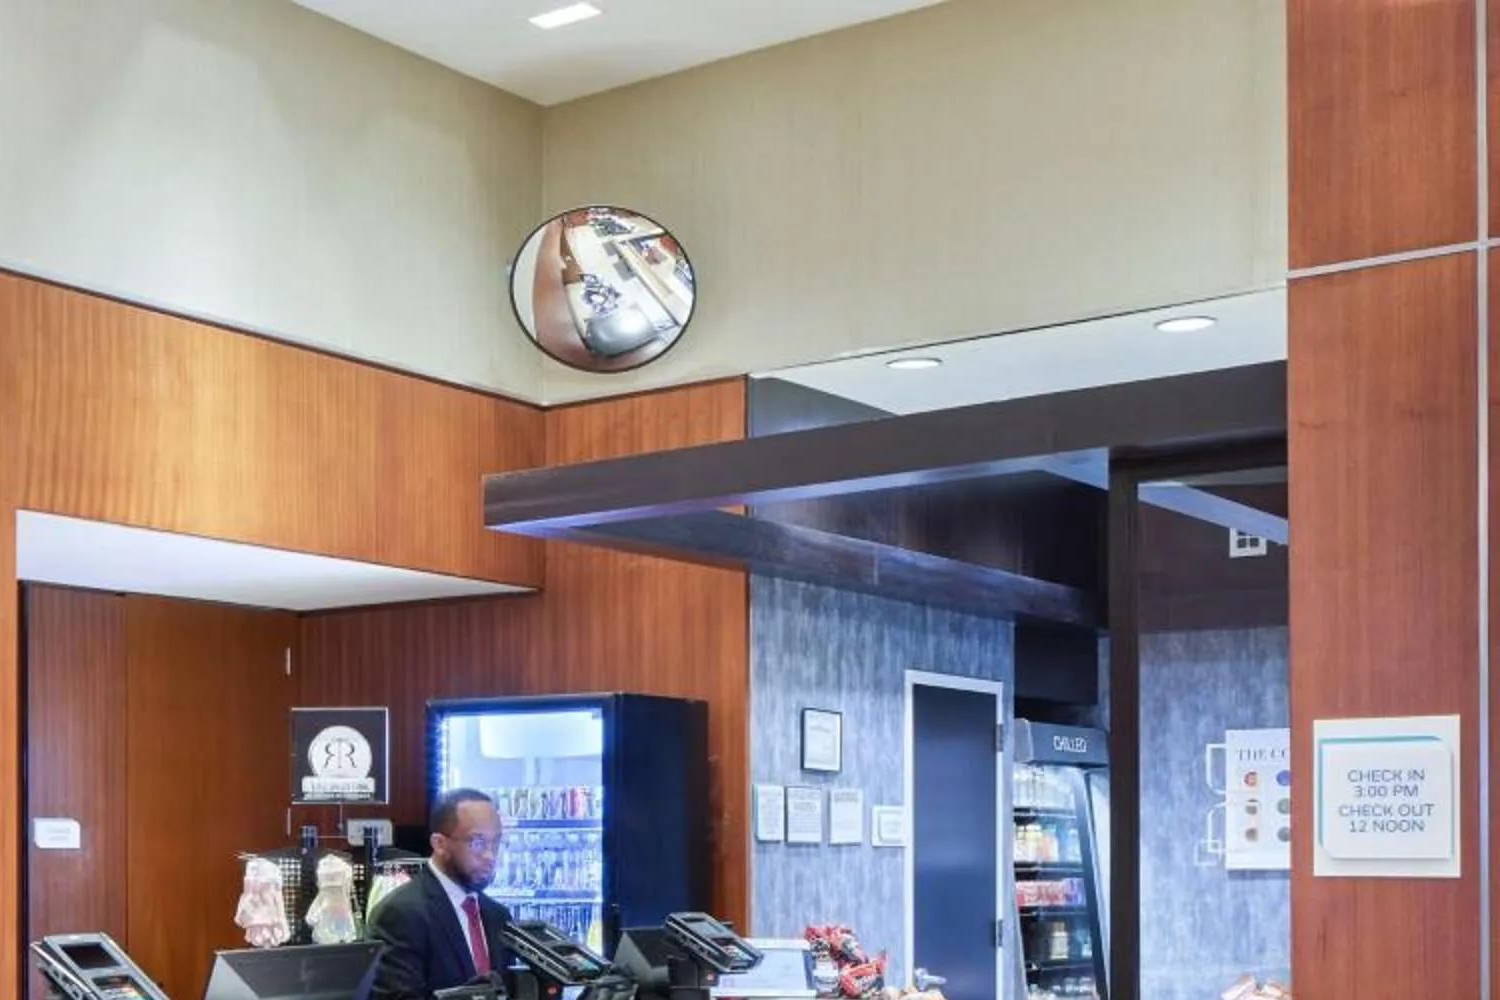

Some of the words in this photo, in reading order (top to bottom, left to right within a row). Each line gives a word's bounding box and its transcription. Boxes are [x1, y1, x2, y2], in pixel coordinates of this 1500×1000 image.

[1347, 769, 1403, 782] CHECK
[1407, 768, 1425, 781] IN
[1354, 785, 1388, 797] 3:00
[1393, 784, 1419, 797] PM
[1338, 803, 1393, 817] CHECK
[1397, 803, 1435, 817] OUT
[1349, 819, 1367, 833] 12
[1372, 819, 1426, 833] NOON
